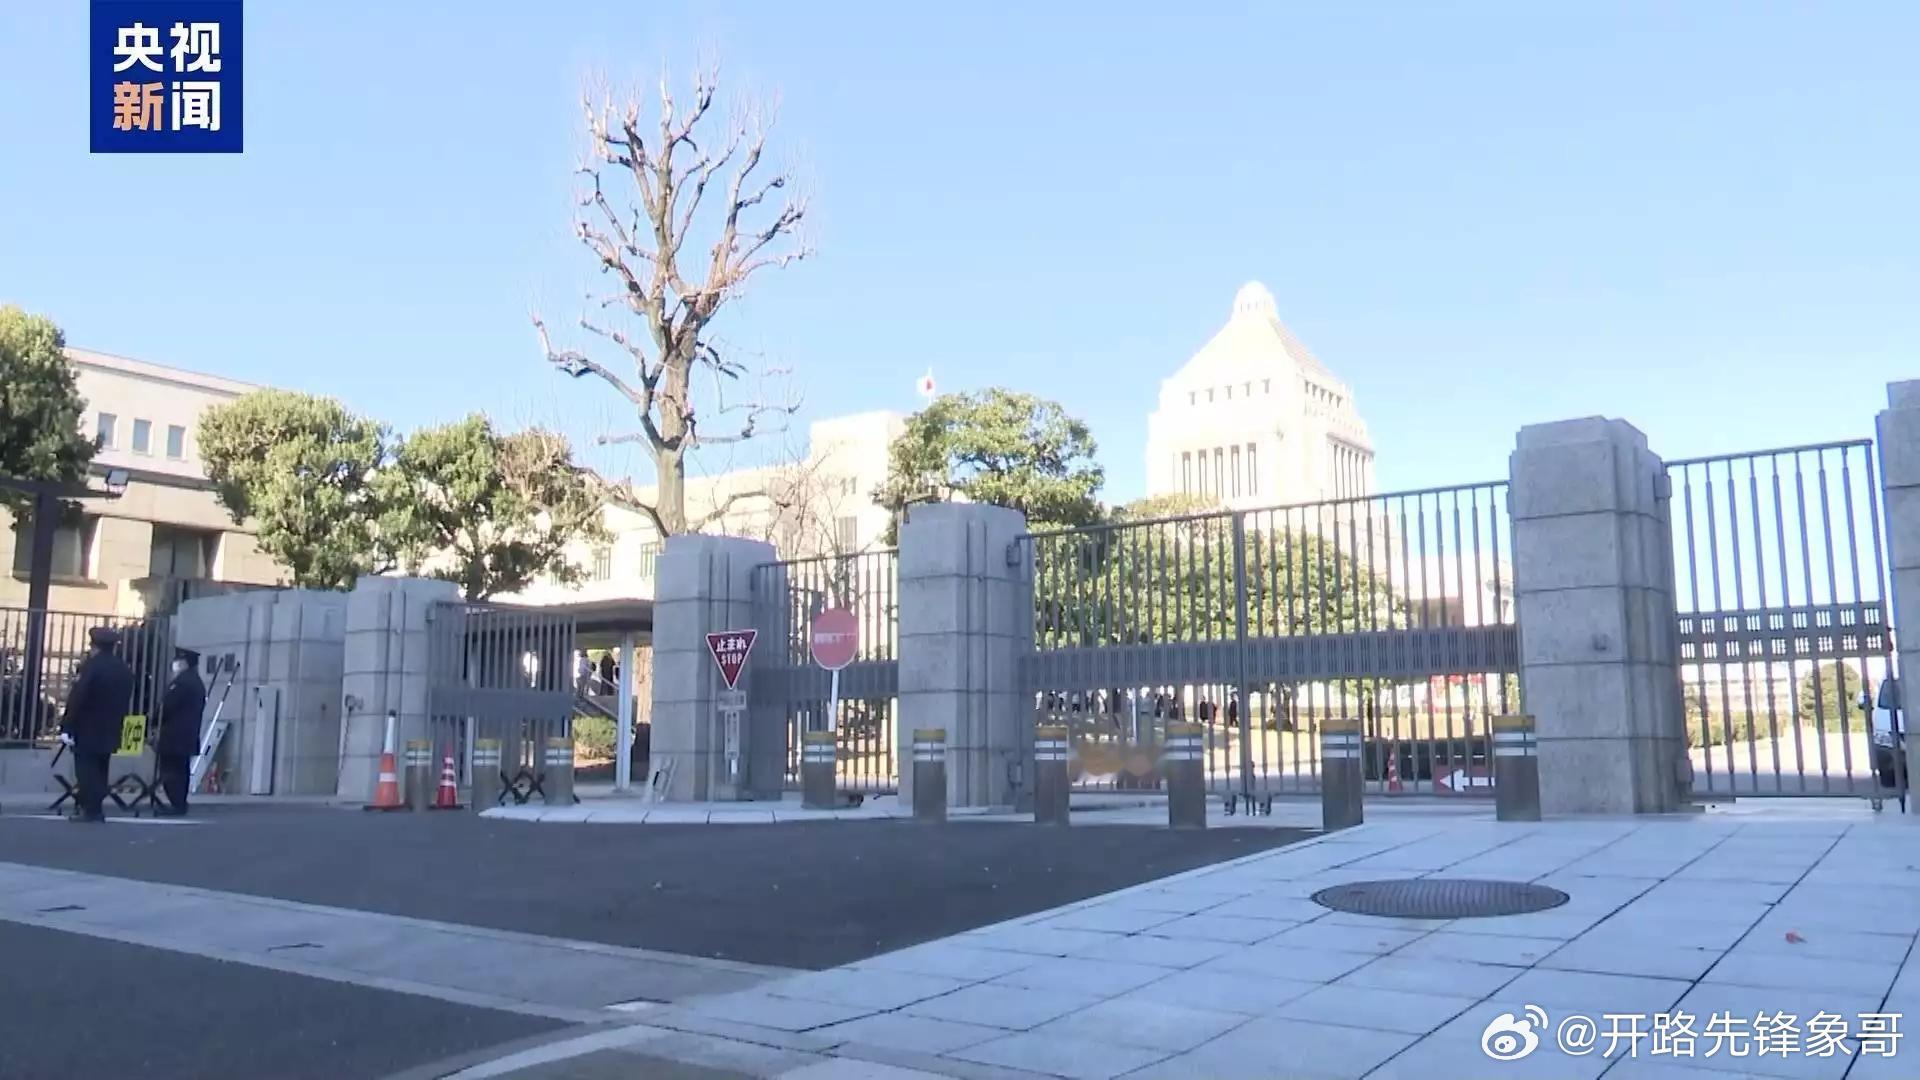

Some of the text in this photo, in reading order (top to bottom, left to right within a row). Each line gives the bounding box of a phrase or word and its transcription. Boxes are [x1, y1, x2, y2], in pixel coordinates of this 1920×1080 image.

[716, 636, 747, 652] 止まれ
[721, 653, 743, 665] STOP
